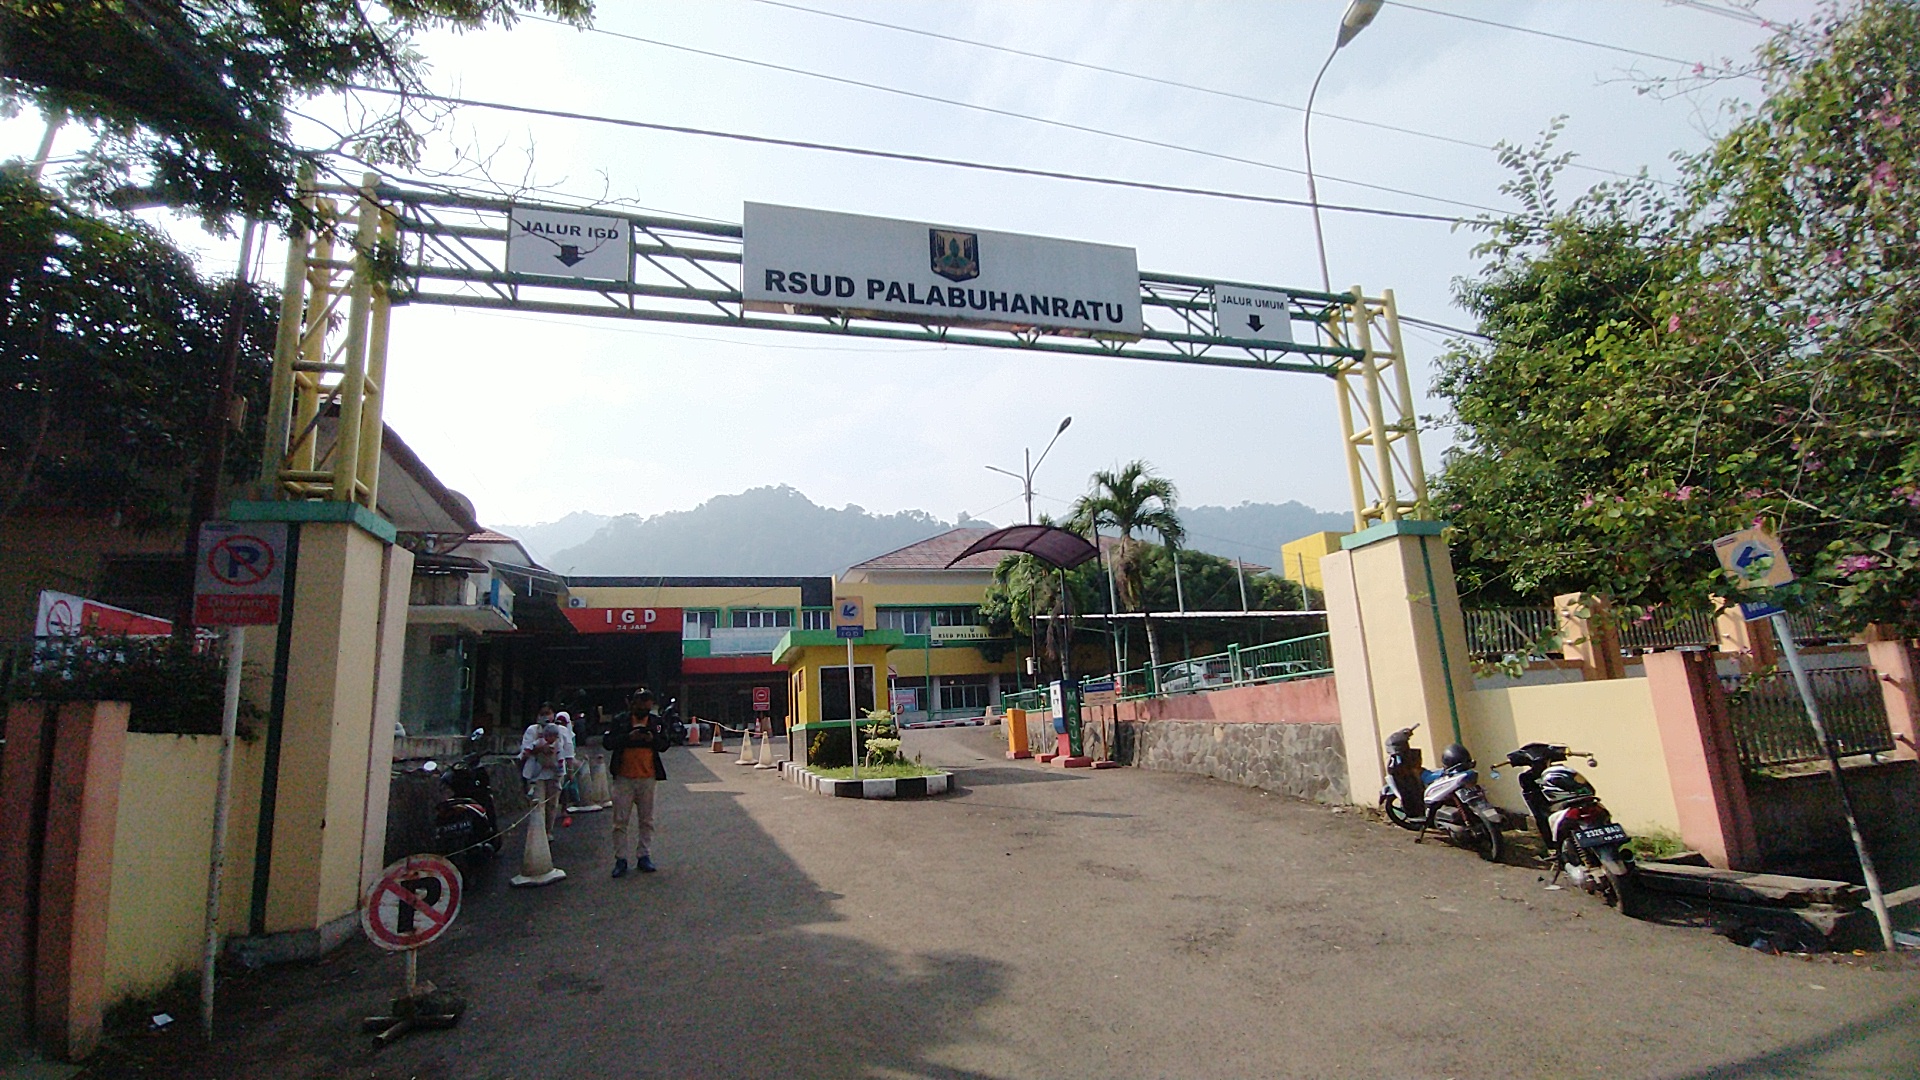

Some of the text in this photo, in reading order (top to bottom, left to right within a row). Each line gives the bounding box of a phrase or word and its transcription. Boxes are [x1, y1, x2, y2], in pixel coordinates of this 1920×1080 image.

[522, 221, 619, 240] JALUR IGD
[765, 269, 1124, 324] RSUD PALABUHANRATU
[1221, 295, 1285, 310] JALUR UMUM
[606, 609, 657, 624] IGD
[1066, 691, 1081, 752] MASUK
